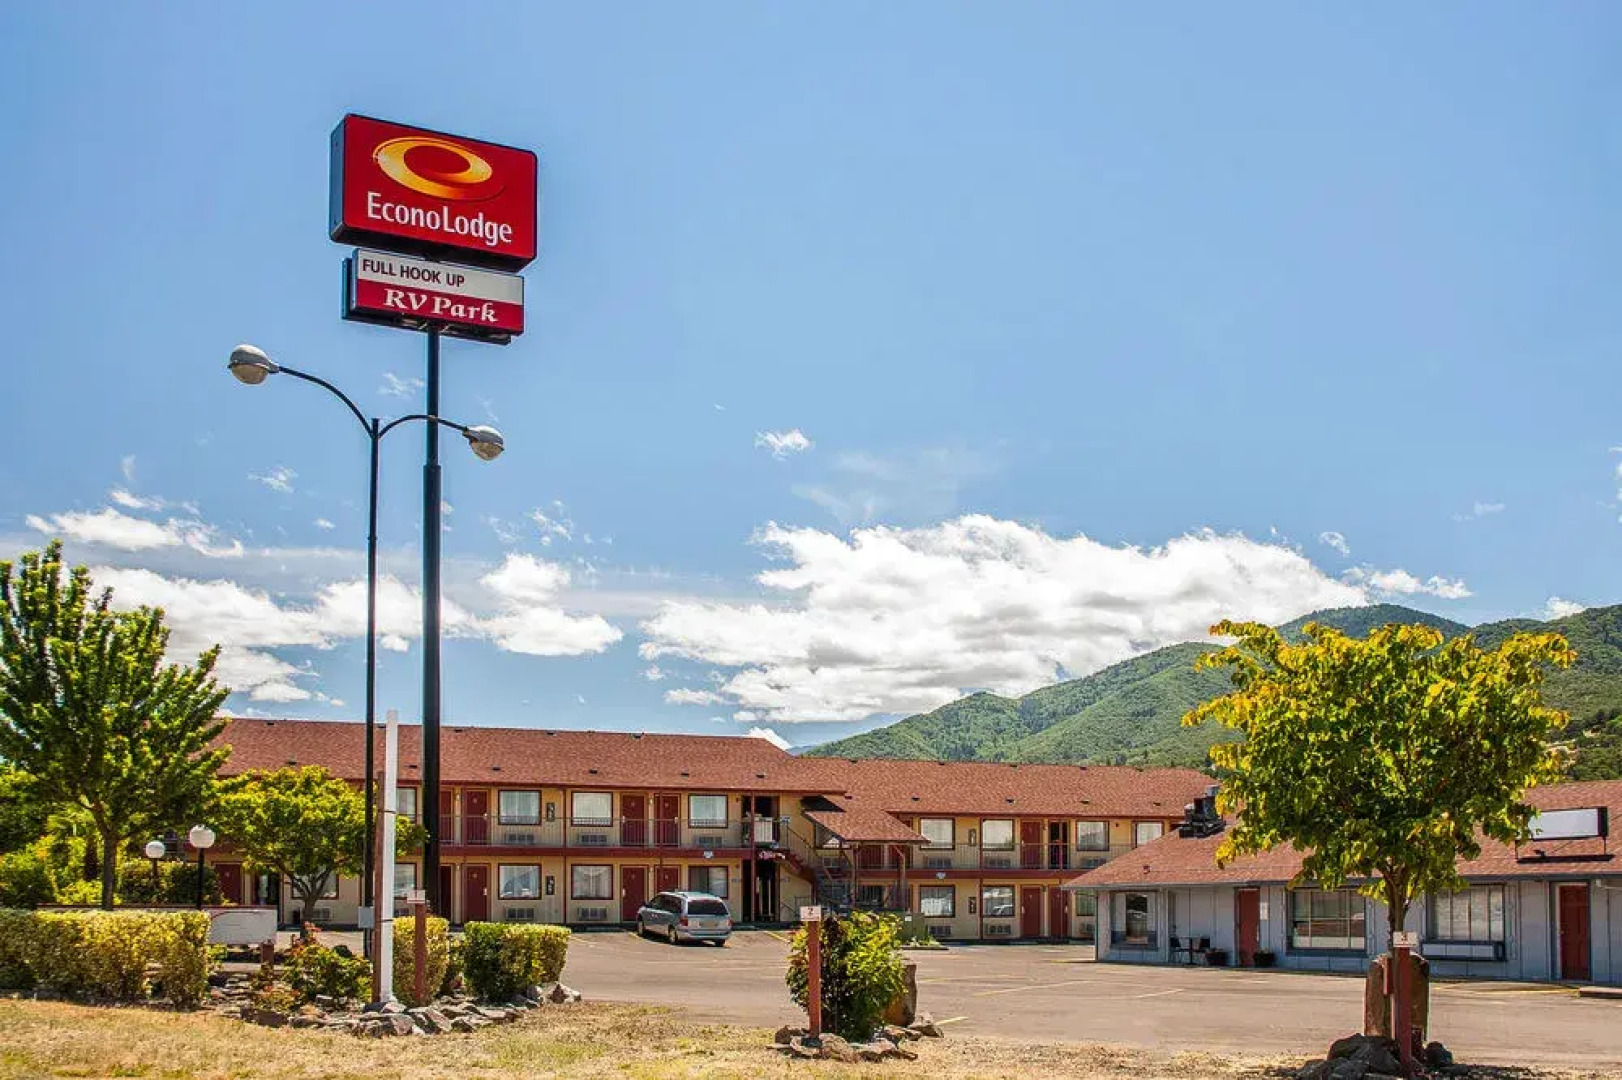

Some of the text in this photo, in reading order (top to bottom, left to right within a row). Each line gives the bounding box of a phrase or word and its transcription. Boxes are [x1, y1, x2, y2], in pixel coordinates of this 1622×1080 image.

[367, 191, 512, 246] EconoLodge
[362, 258, 465, 288] FULL HOOK UP
[384, 288, 499, 323] RV Park
